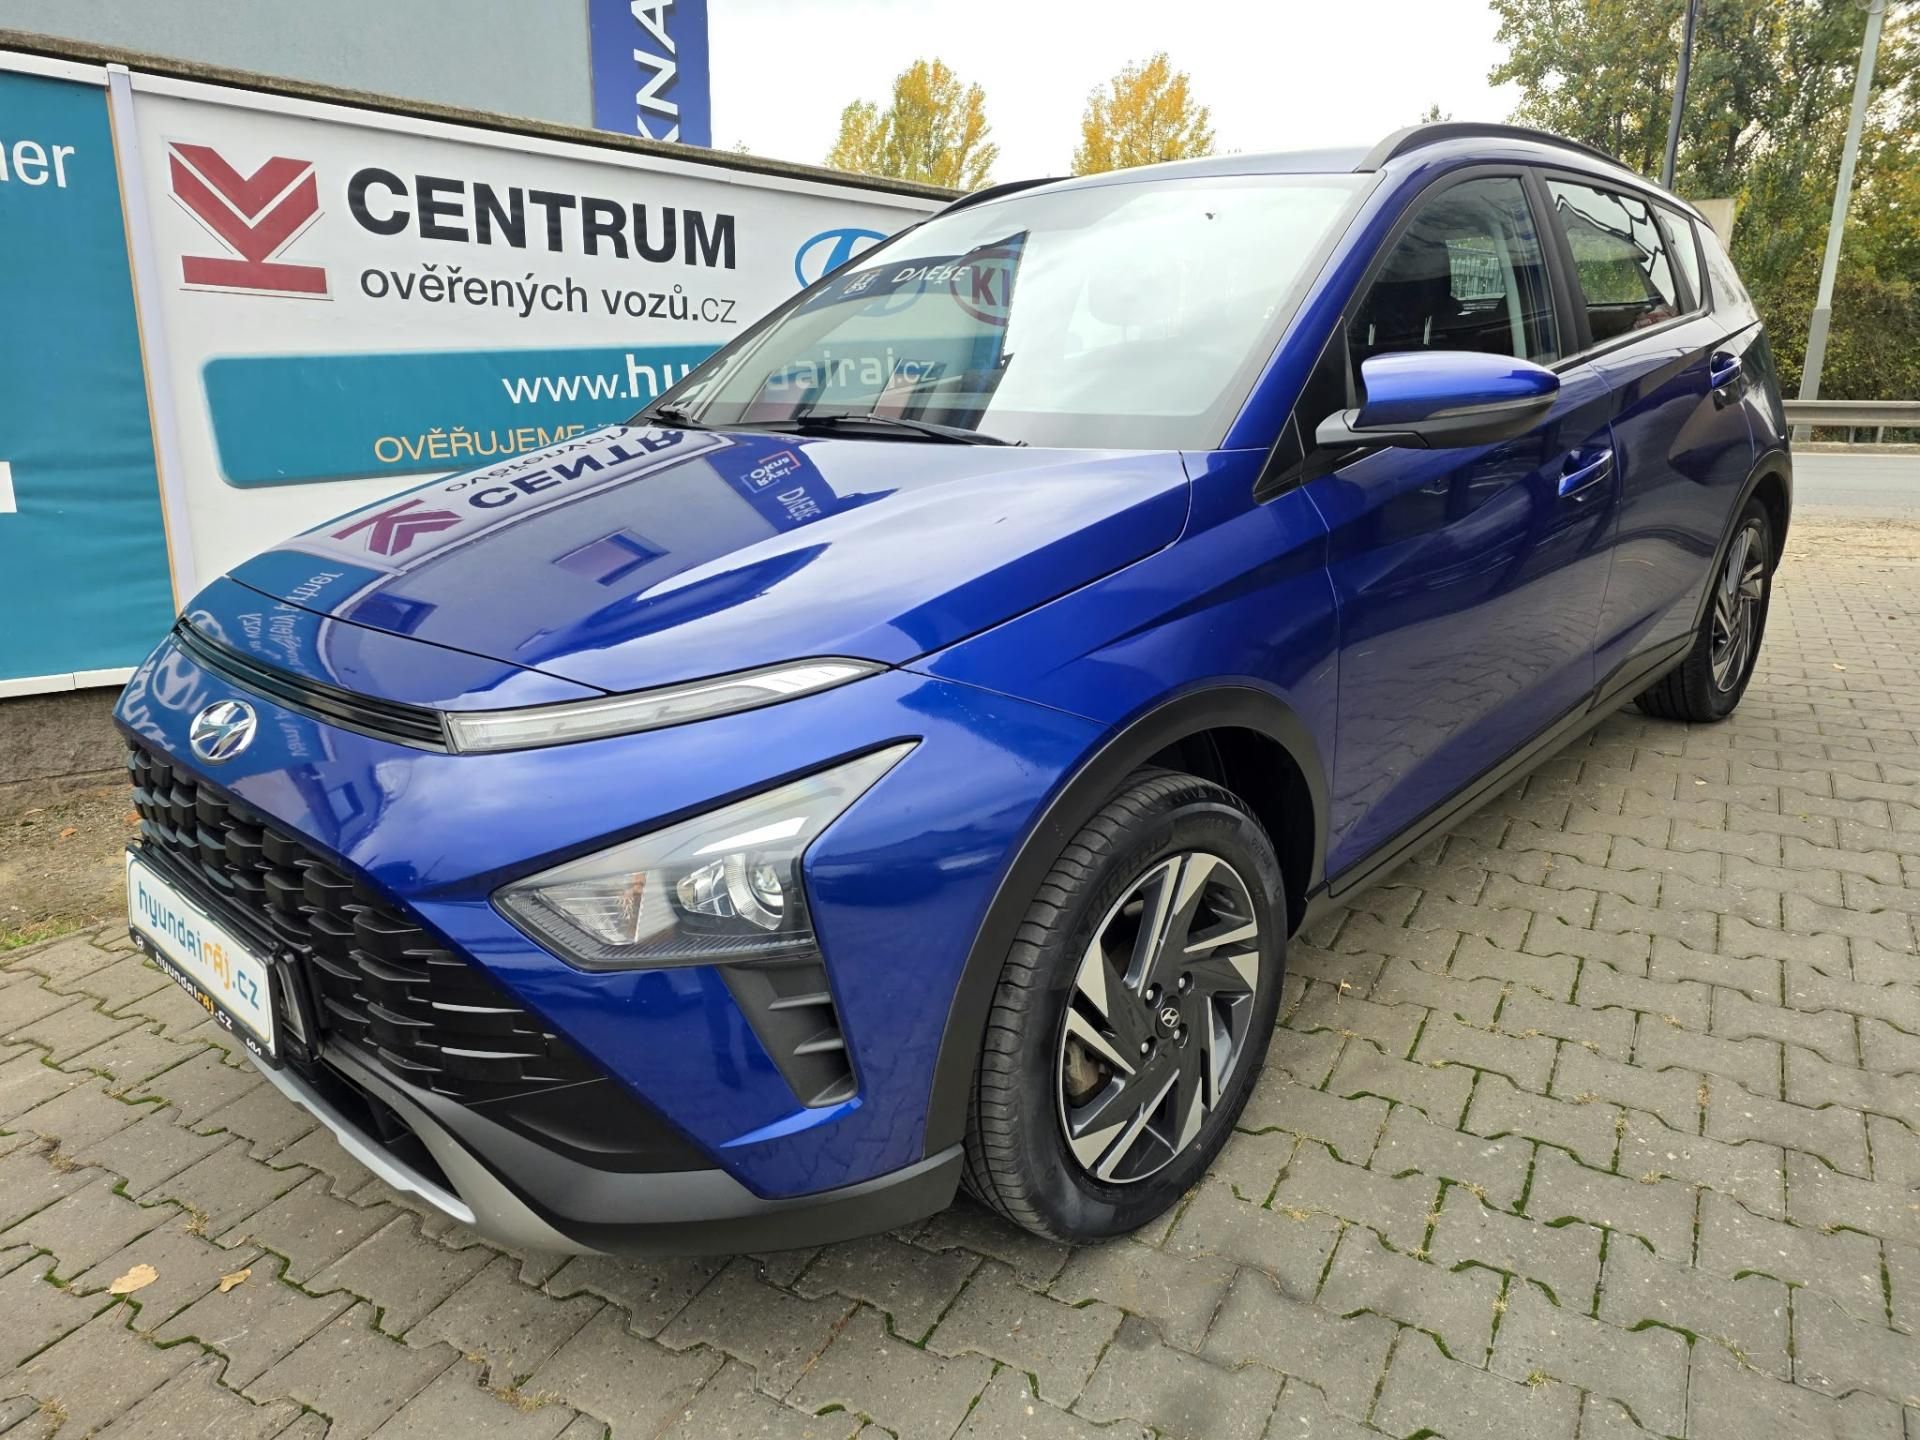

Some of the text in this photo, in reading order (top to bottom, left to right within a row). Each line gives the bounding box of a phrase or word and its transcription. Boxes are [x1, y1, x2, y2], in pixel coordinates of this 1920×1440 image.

[347, 166, 737, 270] CENTRUM
[360, 263, 738, 324] ověřených vozů.cz
[971, 265, 1011, 307] KI
